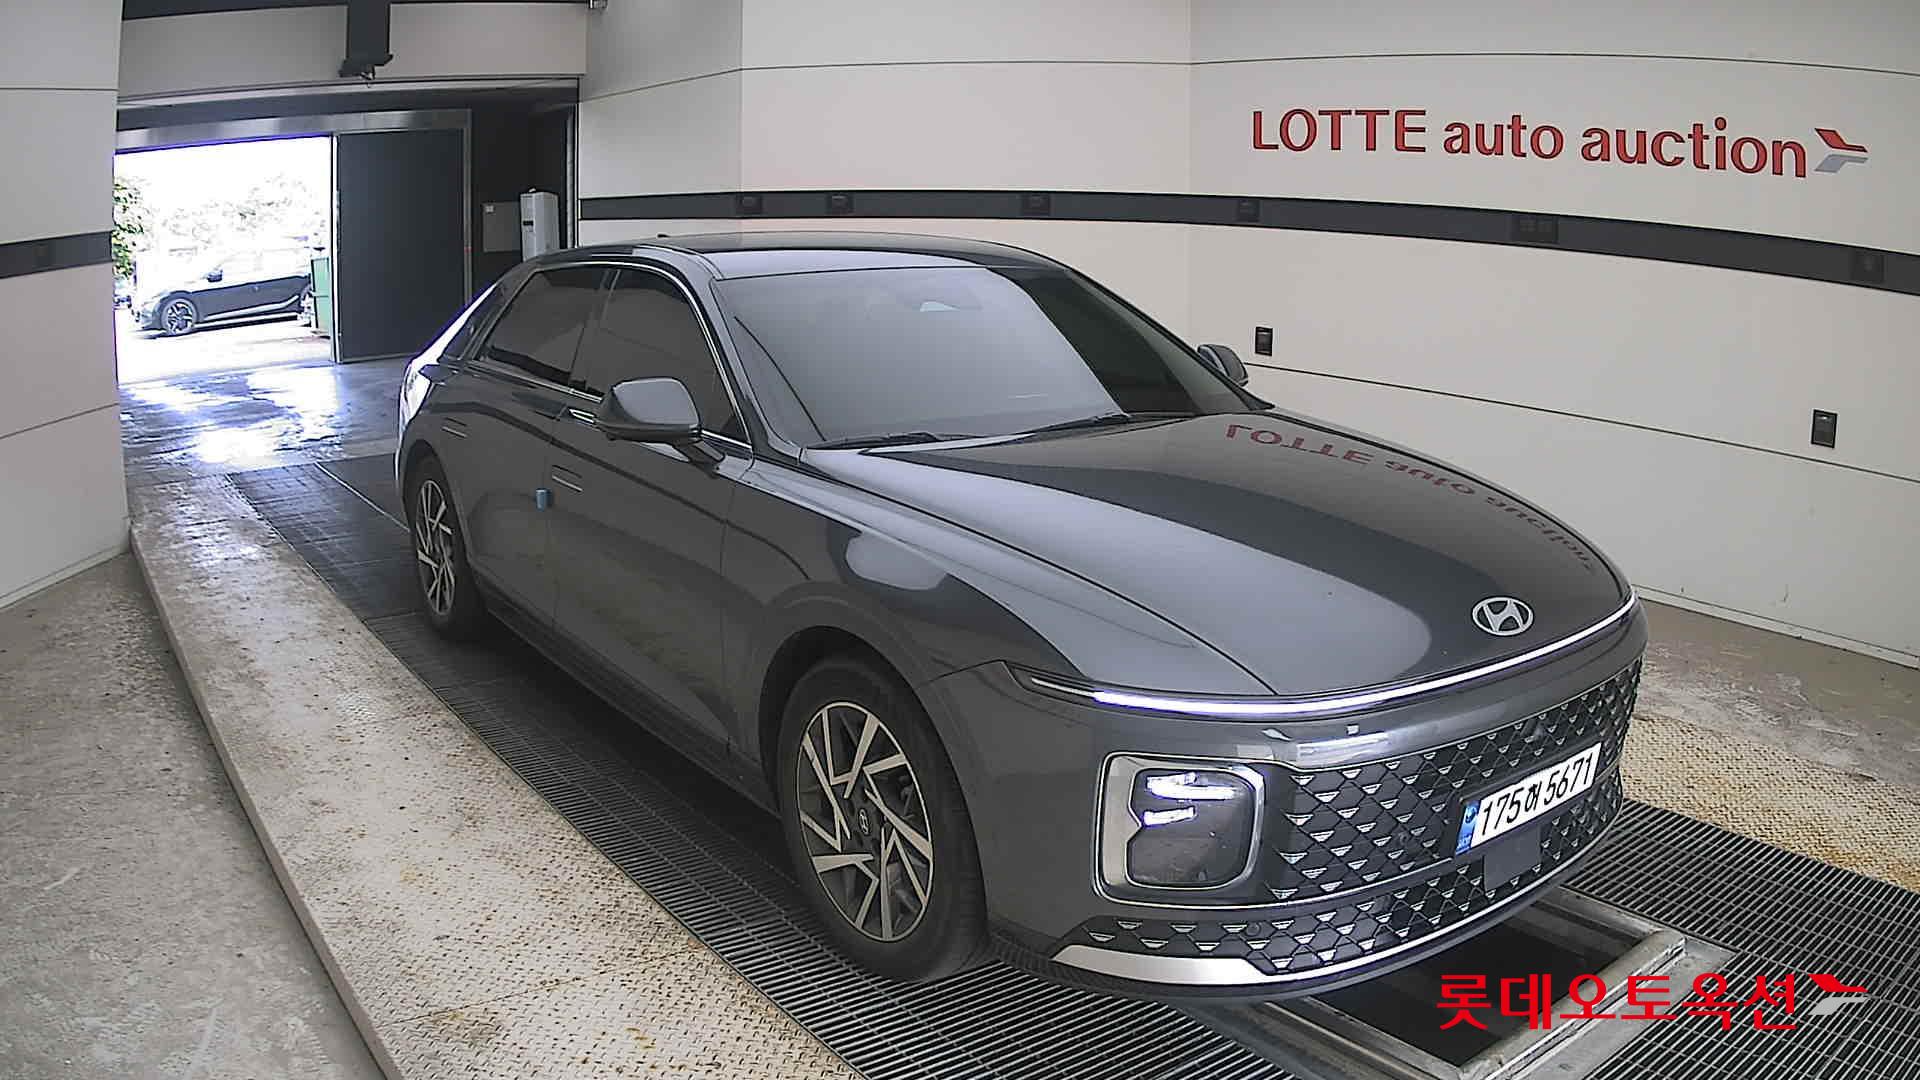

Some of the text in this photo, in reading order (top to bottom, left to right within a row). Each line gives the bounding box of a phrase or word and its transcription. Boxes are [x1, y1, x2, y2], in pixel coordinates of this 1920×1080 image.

[1251, 109, 1809, 179] LOTTE auto auction
